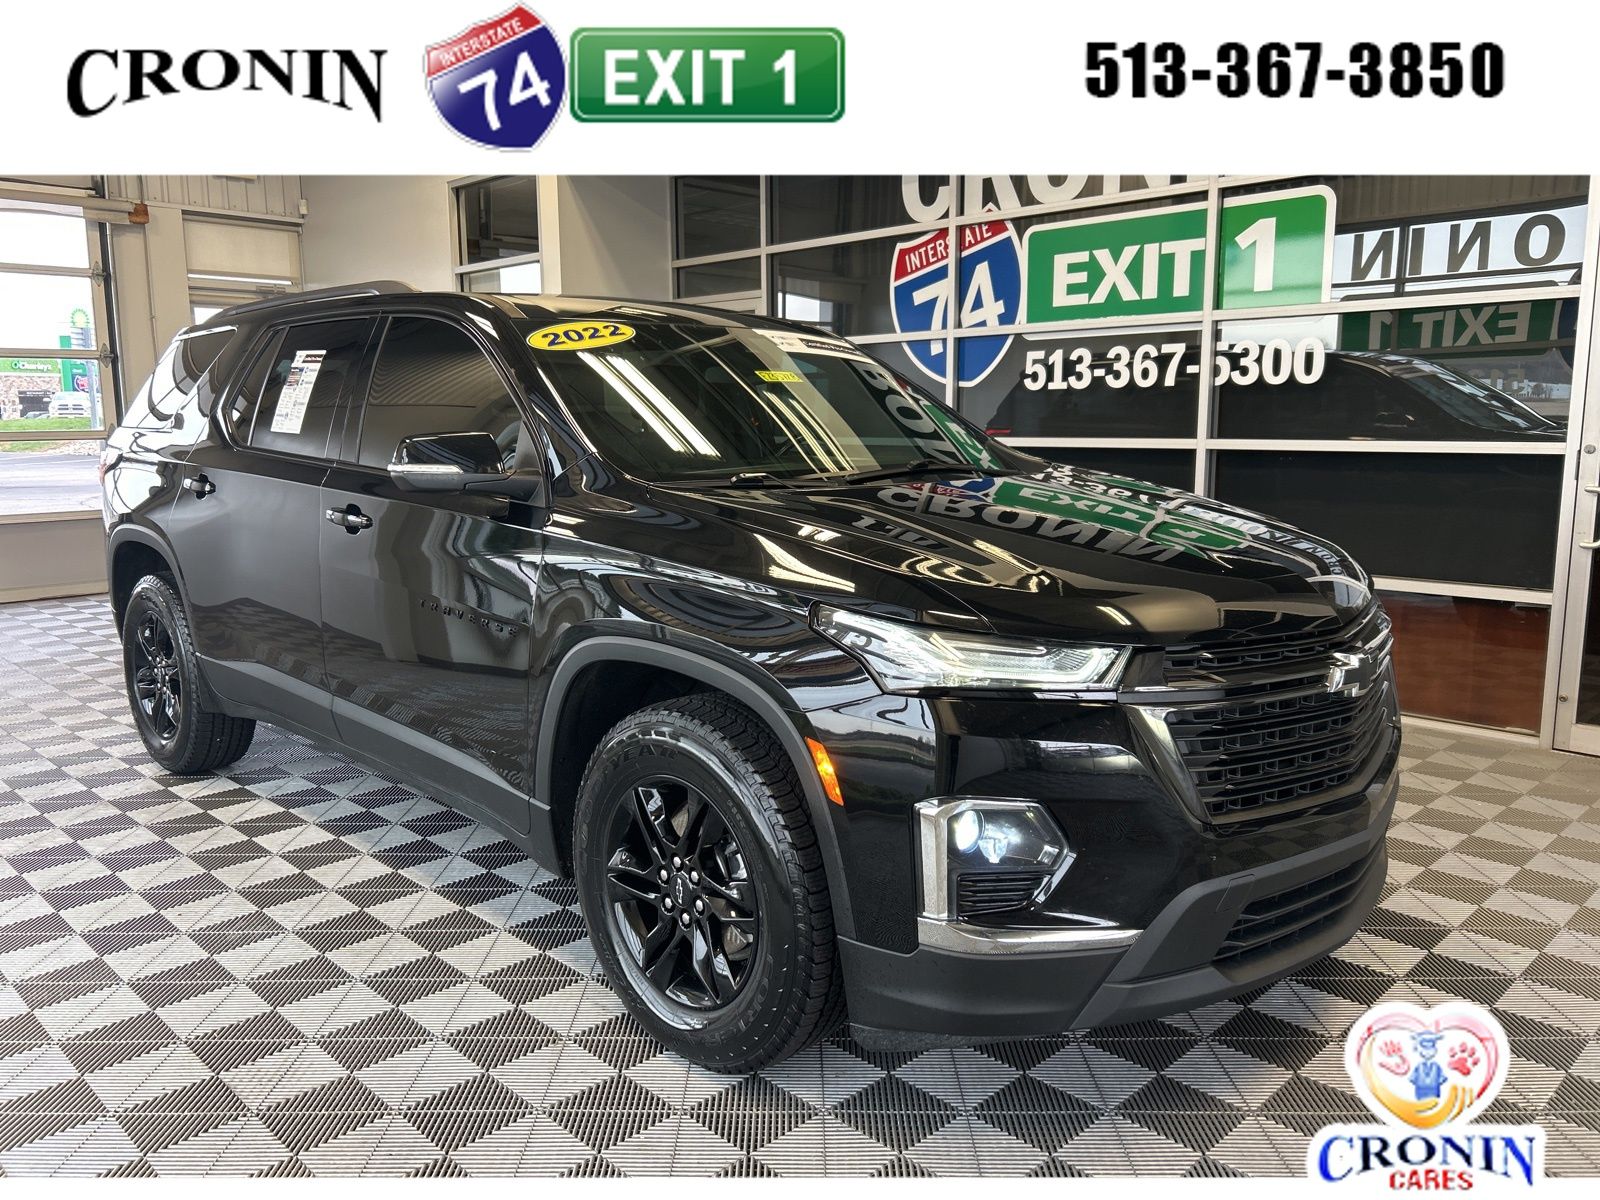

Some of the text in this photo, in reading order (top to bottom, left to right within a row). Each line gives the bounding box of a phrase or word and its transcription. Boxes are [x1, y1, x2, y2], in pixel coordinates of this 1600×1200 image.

[905, 223, 992, 273] INTERATE
[1053, 217, 1277, 307] EXIT 1
[541, 324, 627, 347] 2022
[912, 260, 1005, 356] 74
[1023, 336, 1326, 391] 513-367-5300
